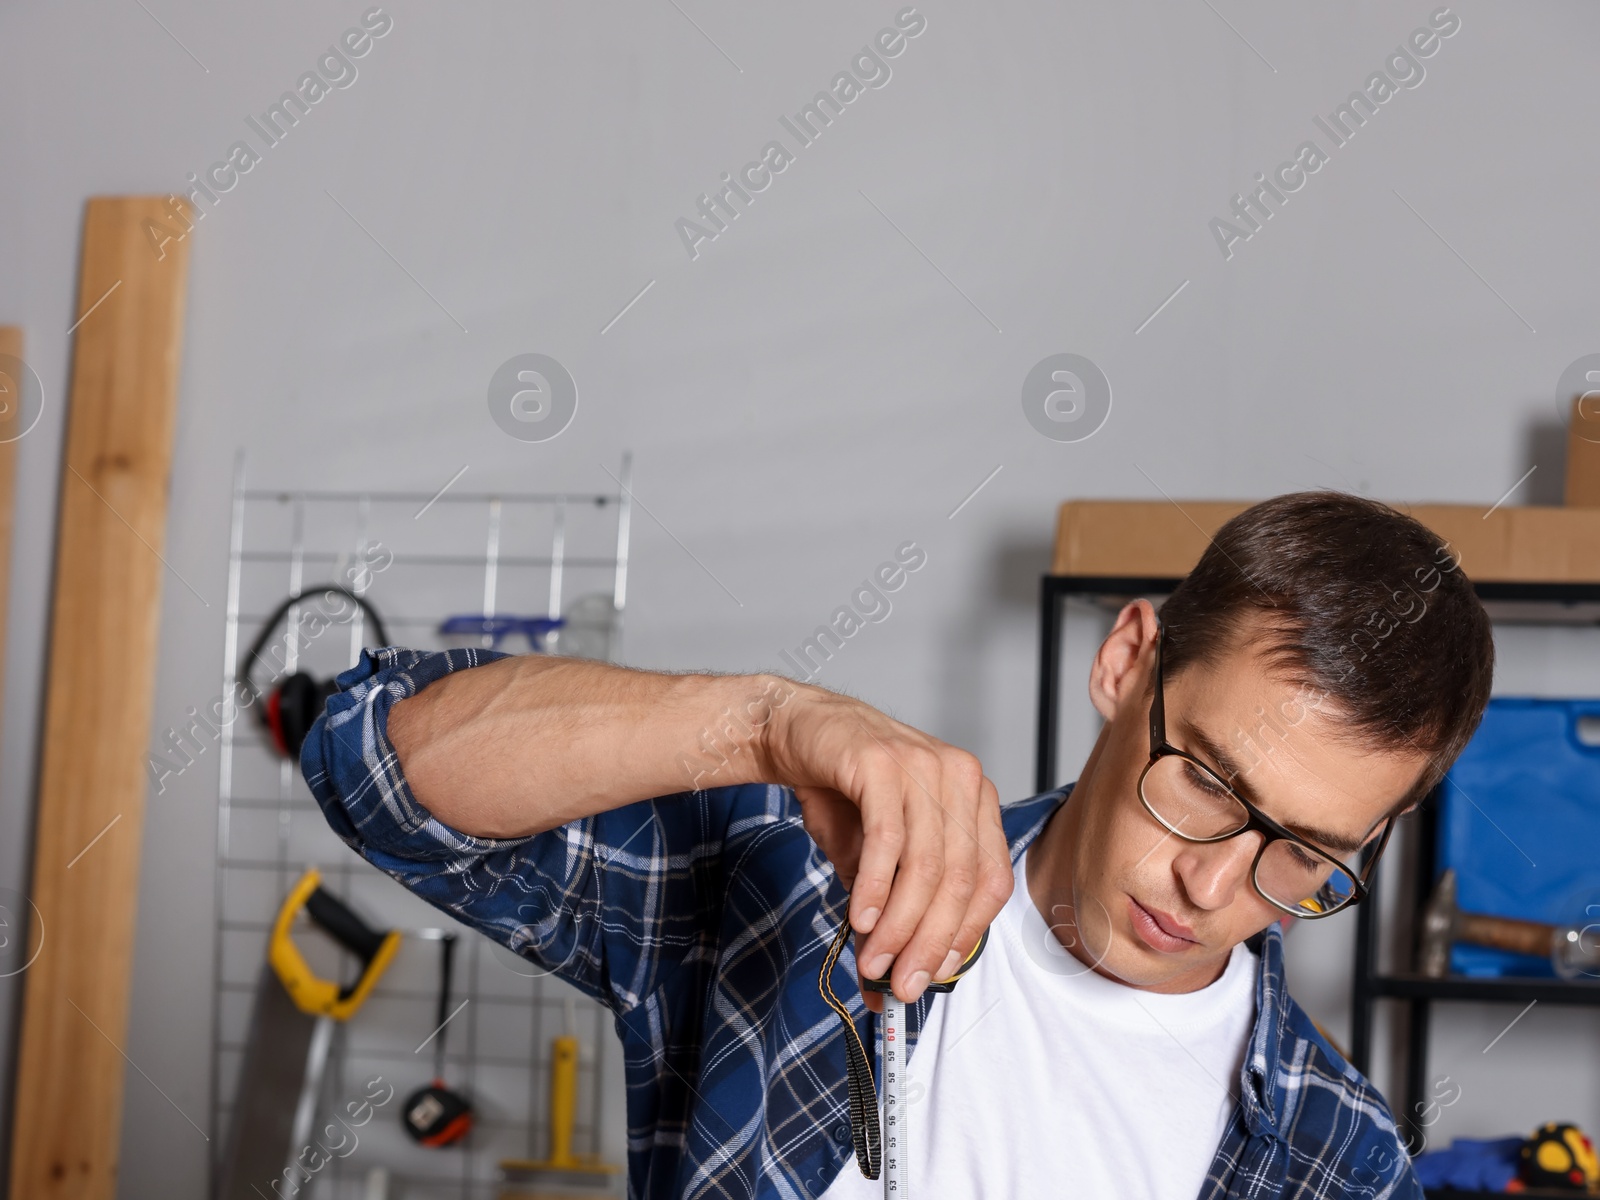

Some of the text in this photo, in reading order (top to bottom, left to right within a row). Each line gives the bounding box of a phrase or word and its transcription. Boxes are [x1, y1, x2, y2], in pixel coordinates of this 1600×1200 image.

[887, 1008, 895, 1019] 61
[886, 1028, 896, 1044] 60
[886, 1050, 896, 1062] 59
[888, 1072, 896, 1084] 58
[888, 1094, 896, 1104] 57
[888, 1116, 896, 1126] 56
[888, 1136, 896, 1148] 55
[888, 1158, 896, 1170] 54
[888, 1180, 896, 1192] 53
